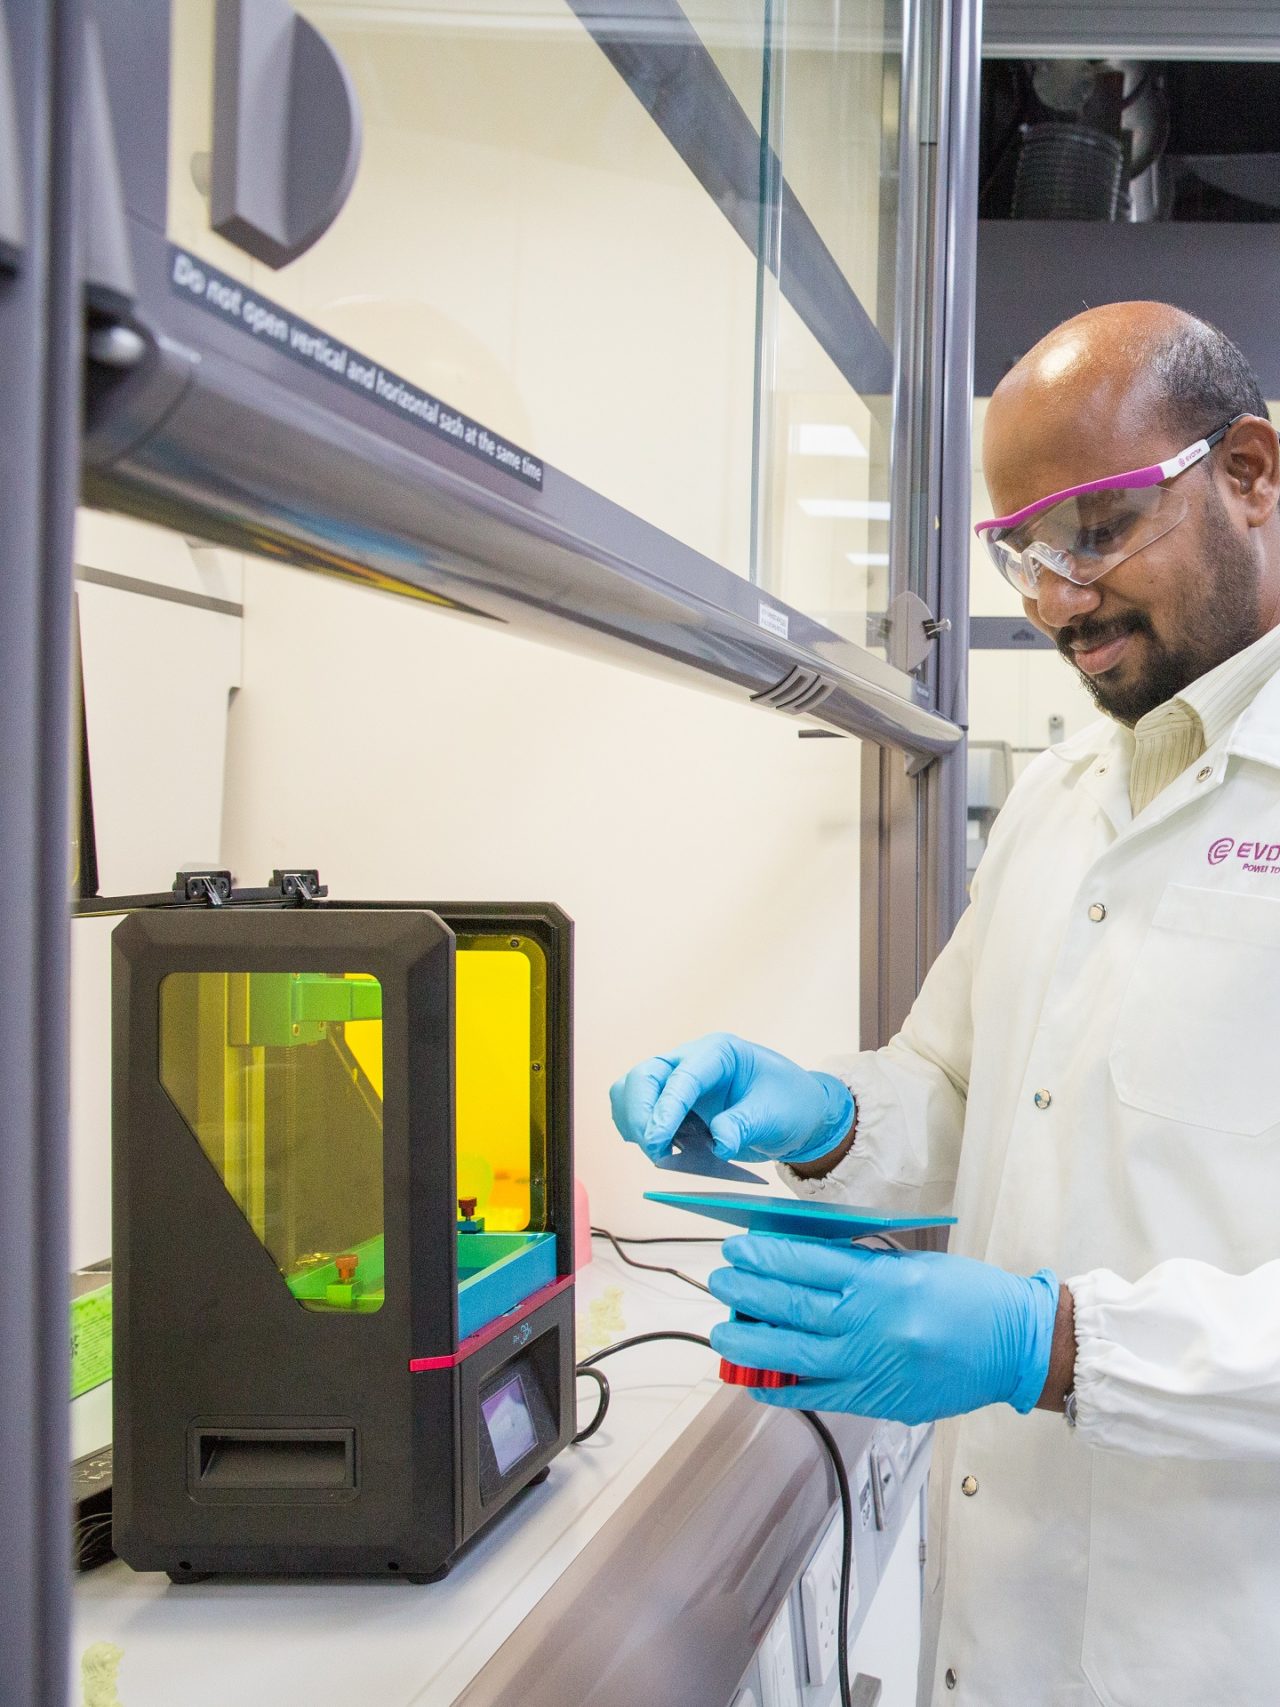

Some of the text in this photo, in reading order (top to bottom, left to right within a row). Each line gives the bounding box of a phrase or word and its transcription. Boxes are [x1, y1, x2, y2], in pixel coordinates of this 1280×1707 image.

[173, 254, 542, 482] Do not open vertical and horizontal sash at the same time
[1270, 866, 1280, 874] TO
